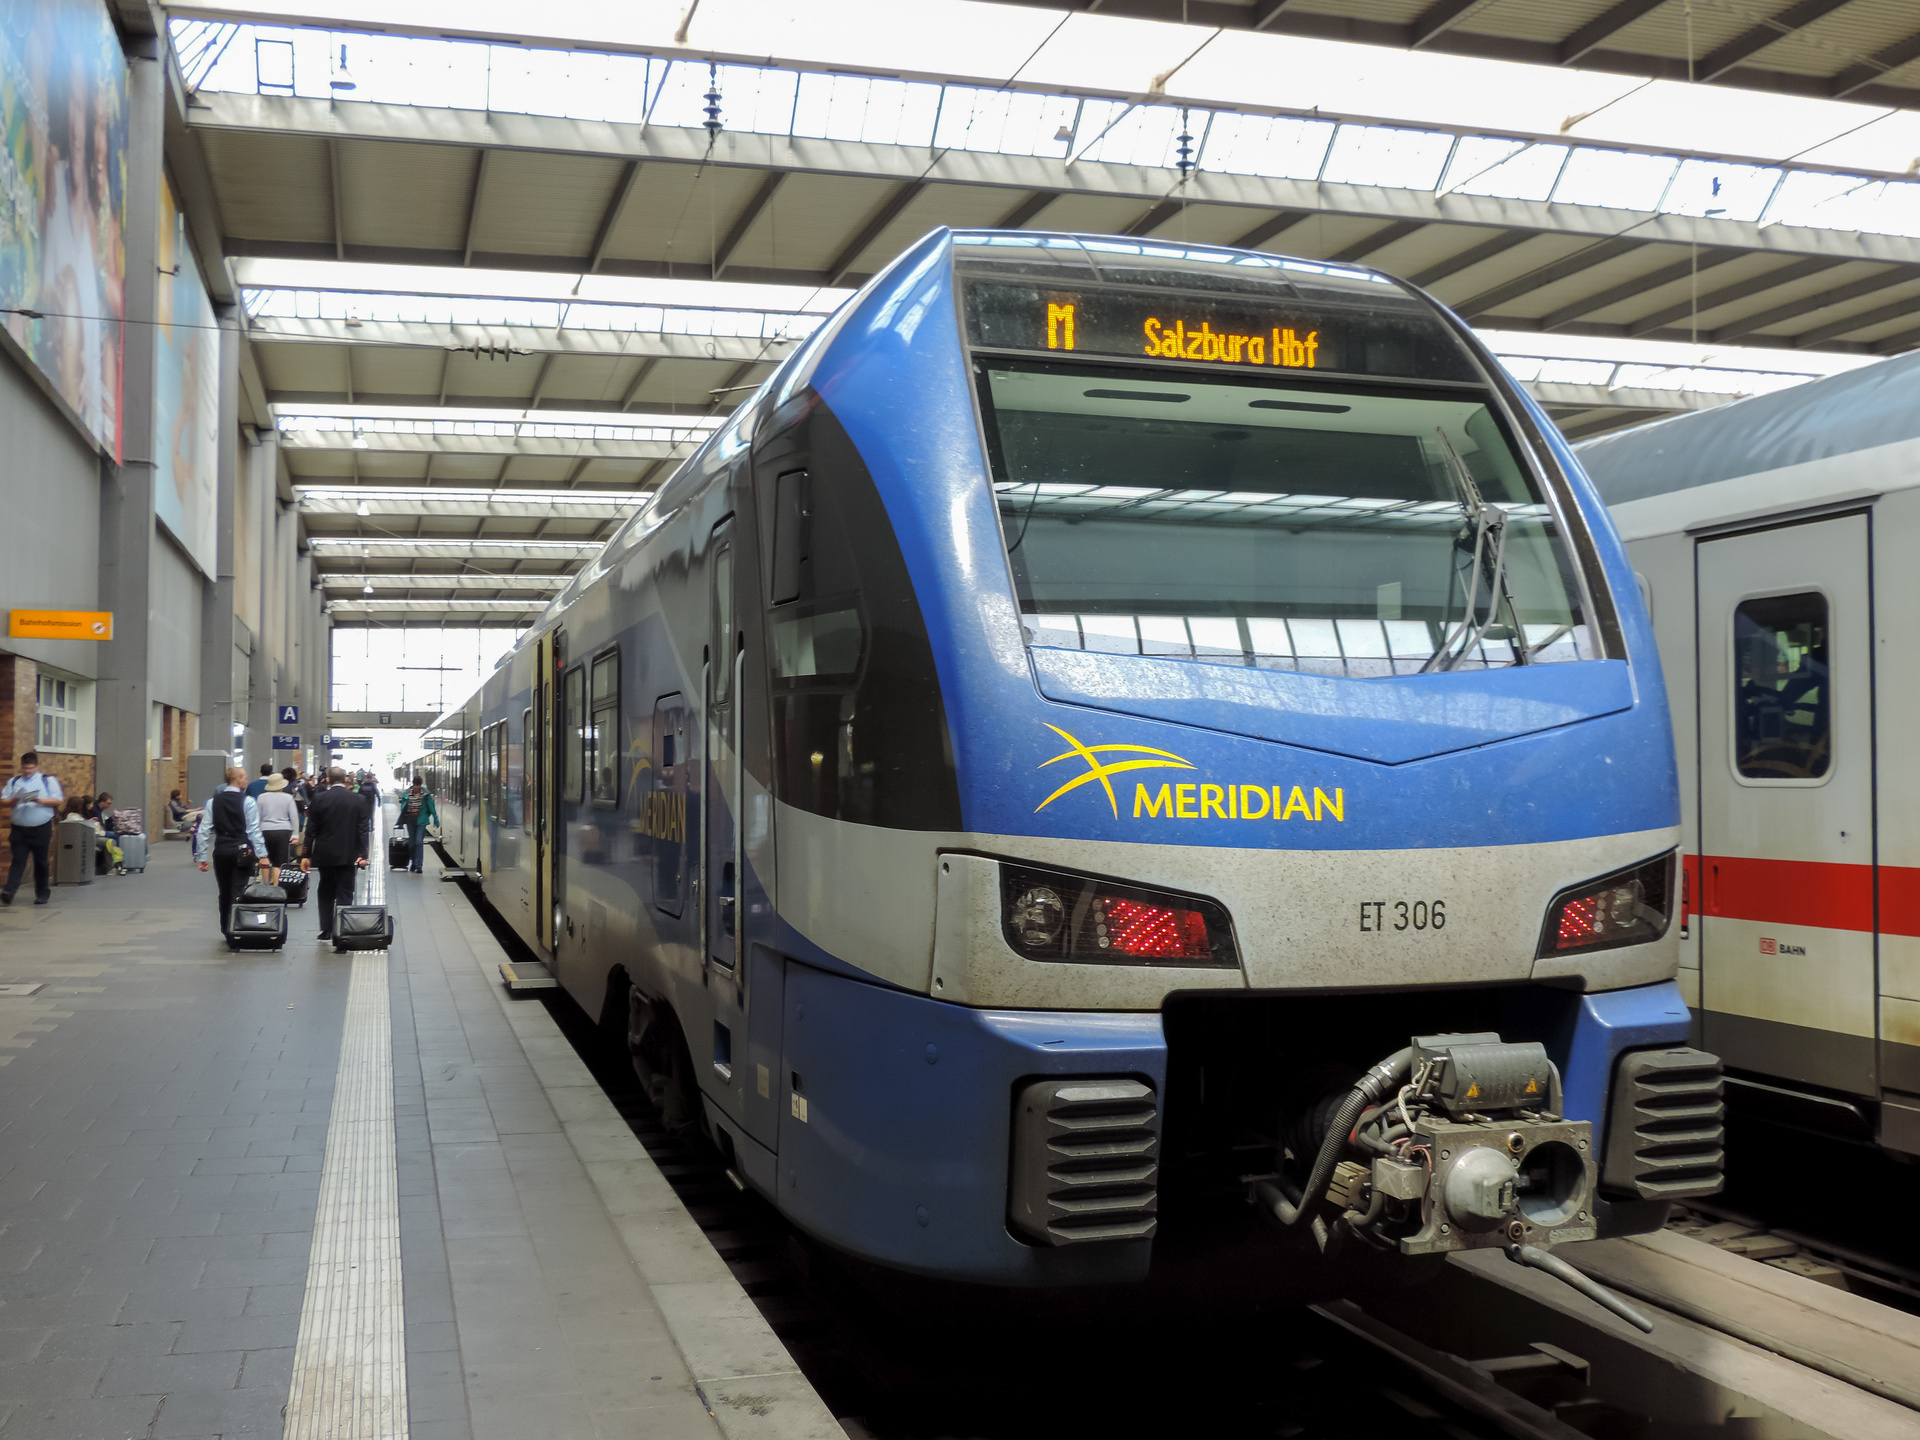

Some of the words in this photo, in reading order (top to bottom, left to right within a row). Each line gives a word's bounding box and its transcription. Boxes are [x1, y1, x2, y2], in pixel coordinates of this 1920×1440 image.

[1047, 303, 1074, 350] M
[1272, 328, 1319, 368] Hbf
[19, 618, 82, 627] Bahnhofsmission
[283, 706, 296, 721] A
[323, 734, 331, 744] B
[639, 790, 686, 844] MERIDIAN
[1133, 783, 1344, 822] MERIDIAN
[1360, 901, 1386, 931] ET
[1393, 899, 1446, 931] 306
[1779, 943, 1806, 956] BAHN
